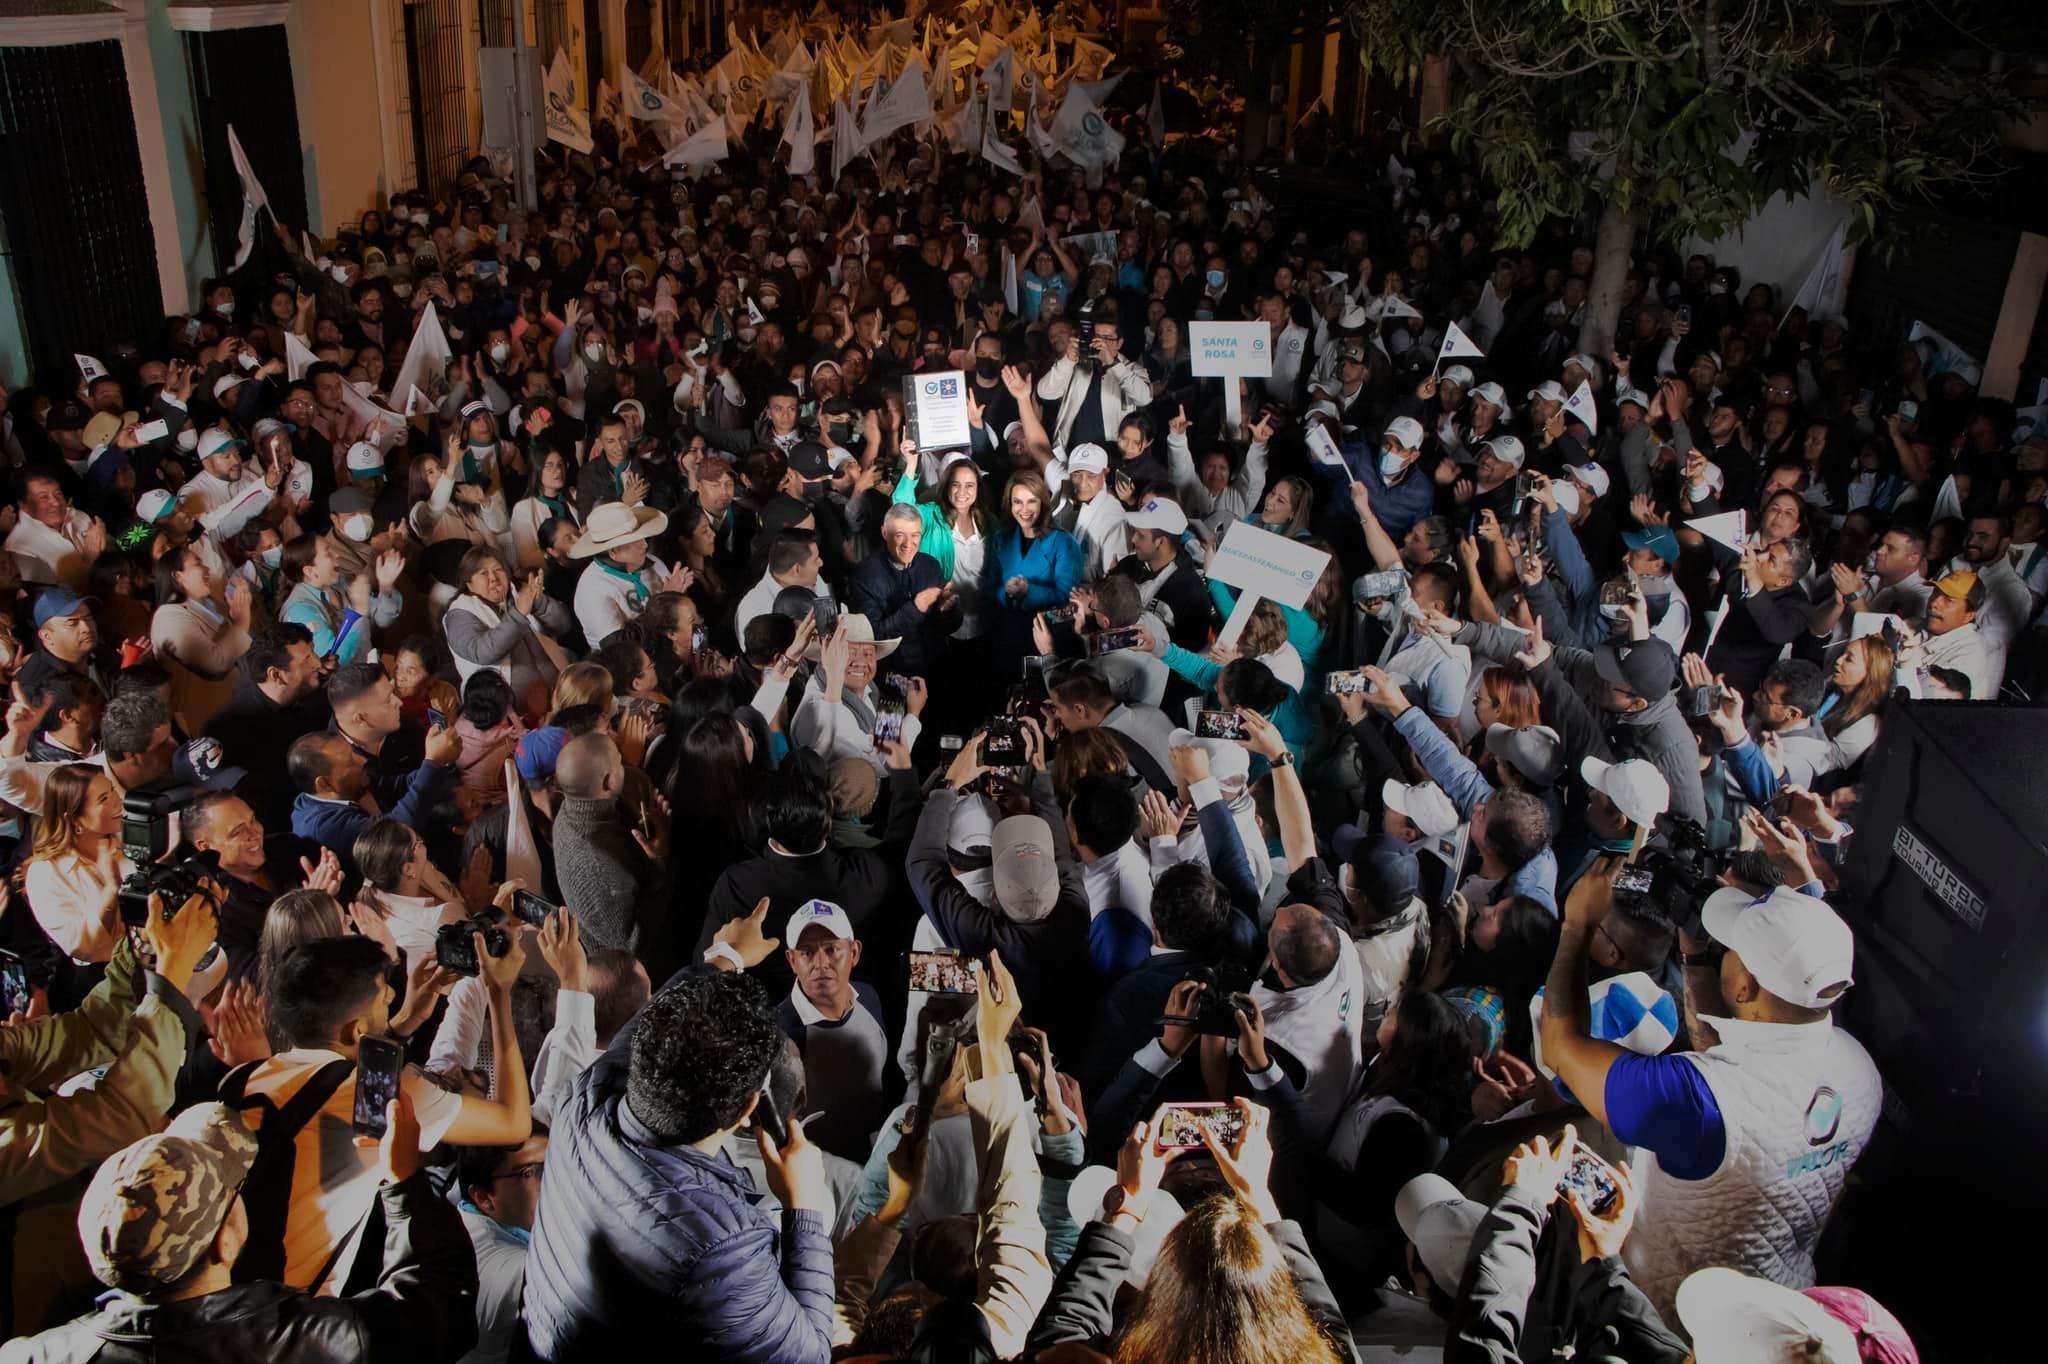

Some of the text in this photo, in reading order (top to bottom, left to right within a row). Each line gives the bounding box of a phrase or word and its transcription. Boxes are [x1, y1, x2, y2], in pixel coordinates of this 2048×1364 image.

[1201, 337, 1238, 347] SANTA
[1204, 349, 1236, 359] ROSA
[1895, 843, 1940, 889] TOURING
